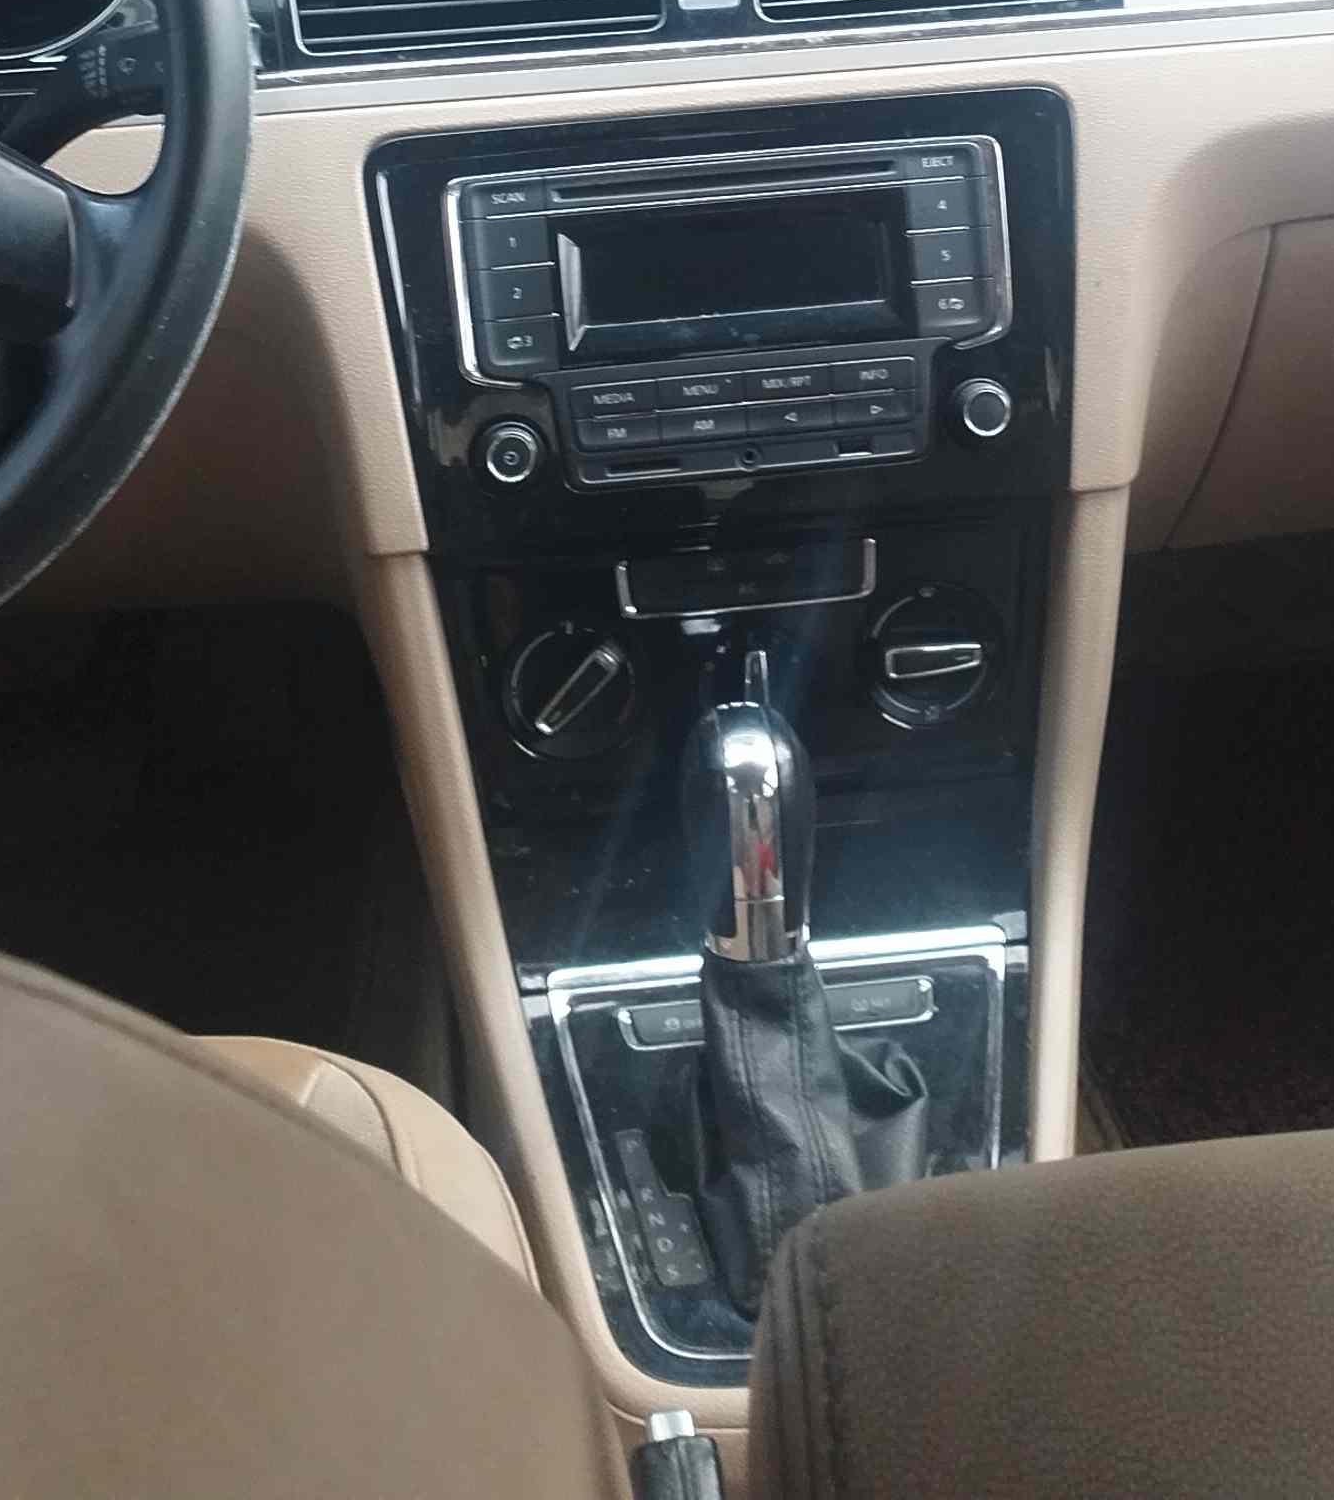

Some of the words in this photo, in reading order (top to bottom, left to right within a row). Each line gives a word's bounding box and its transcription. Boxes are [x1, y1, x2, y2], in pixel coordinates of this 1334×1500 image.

[490, 191, 527, 205] SCAN
[858, 367, 890, 382] INFO
[682, 383, 720, 397] MENU
[592, 391, 636, 406] MEDIA
